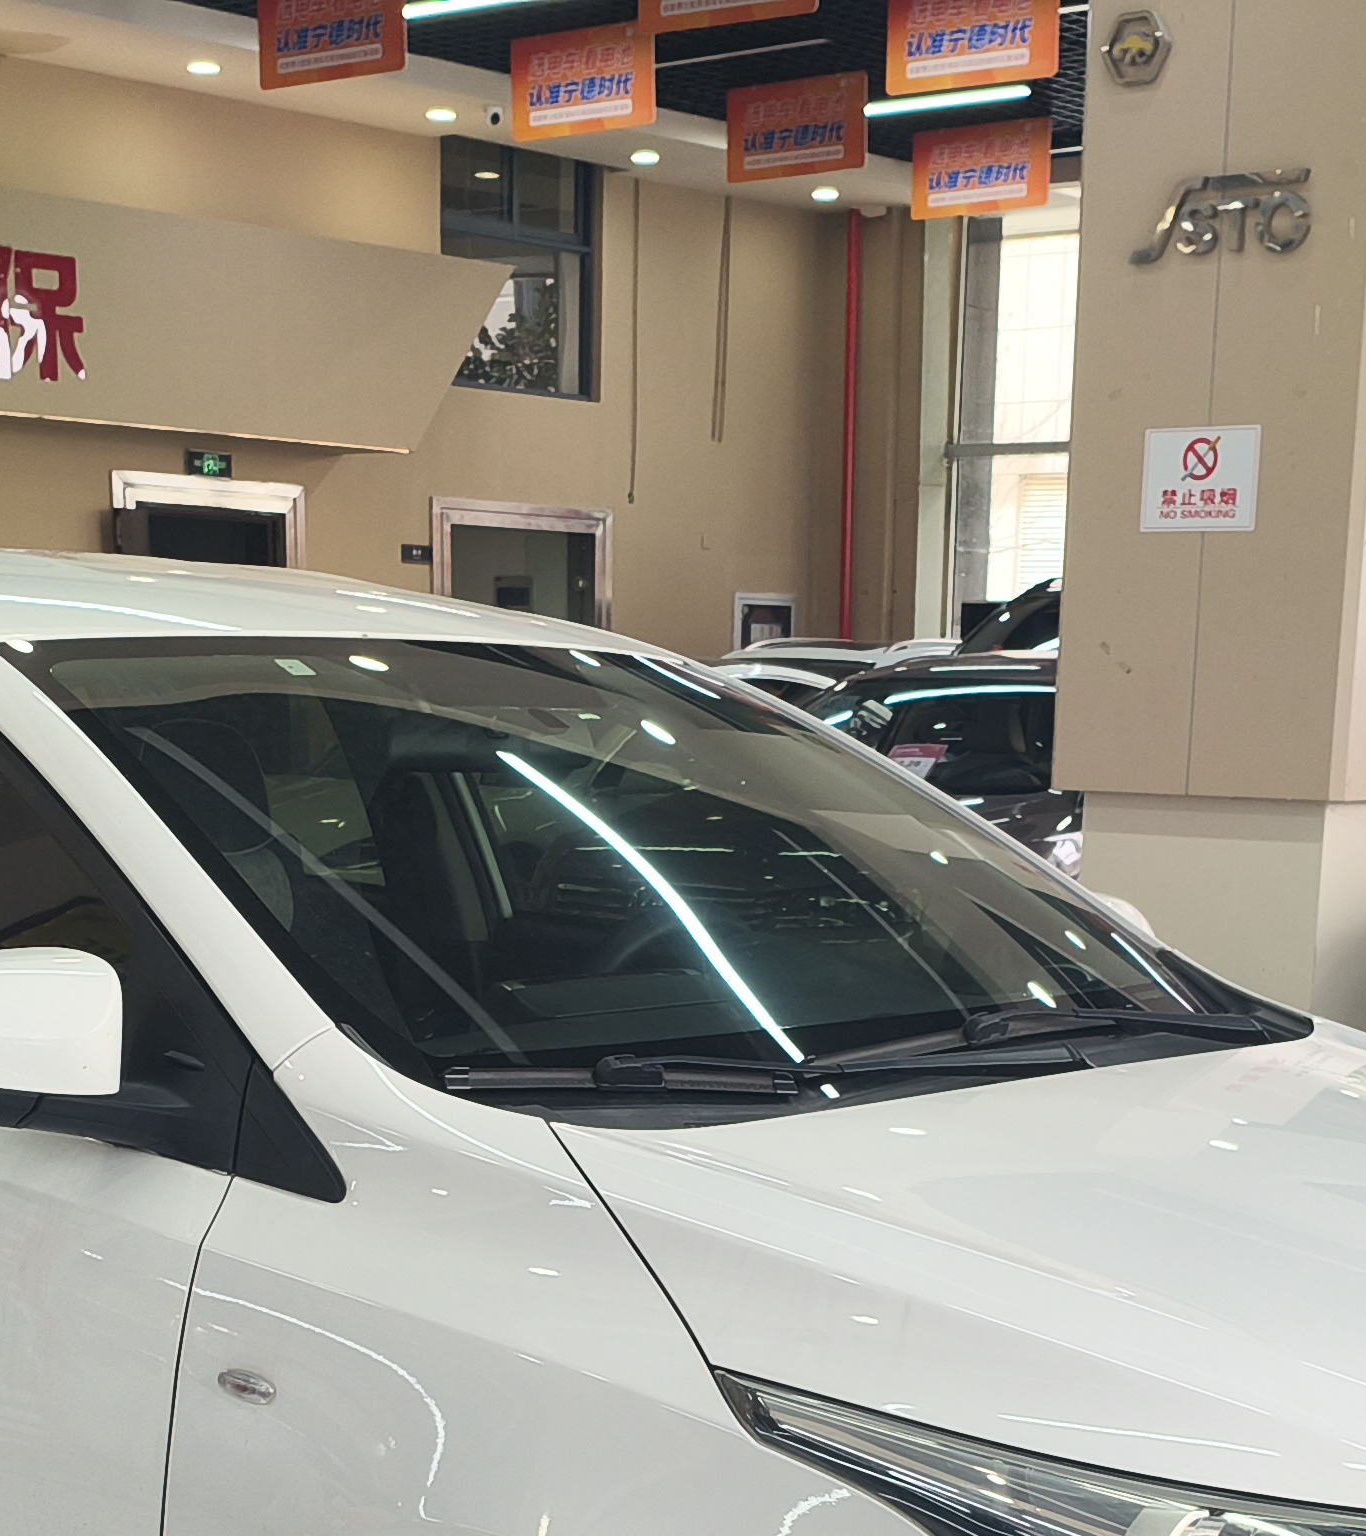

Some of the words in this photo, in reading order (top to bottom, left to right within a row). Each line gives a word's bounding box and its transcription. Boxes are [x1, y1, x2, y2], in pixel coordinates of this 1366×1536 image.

[1160, 487, 1238, 508] 禁止吸烟
[1159, 509, 1178, 520] NO
[1179, 508, 1237, 520] SMOKING
